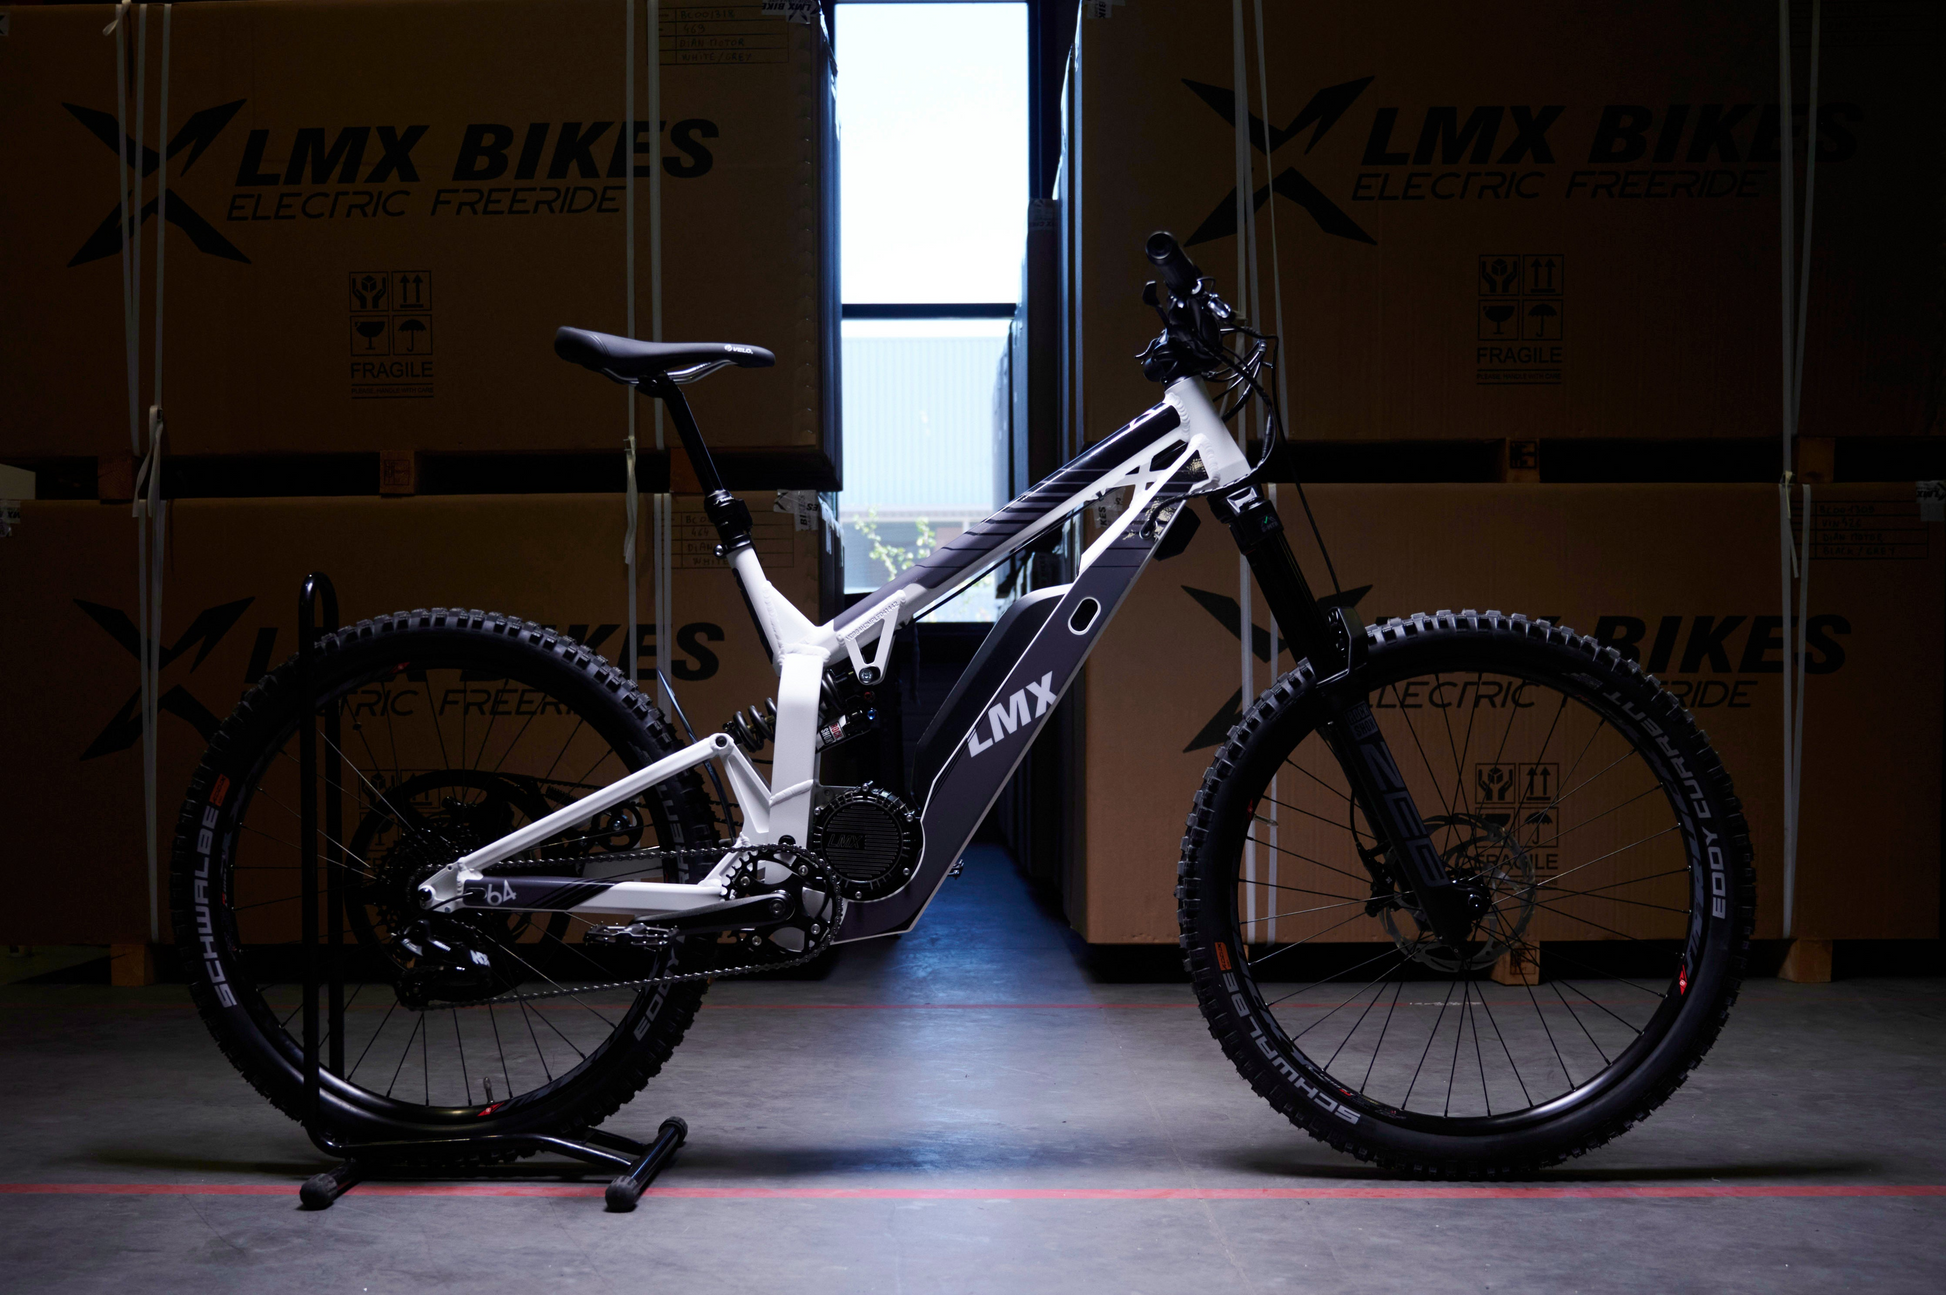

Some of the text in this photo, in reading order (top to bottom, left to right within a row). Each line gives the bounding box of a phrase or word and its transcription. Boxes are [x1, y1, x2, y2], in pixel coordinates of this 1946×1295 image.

[1361, 101, 1864, 165] LMX BIKES
[235, 119, 719, 186] LMX BIKES
[1352, 169, 1768, 201] ELECTRIC FREERIDE
[226, 186, 626, 221] ELECTRIC FREERIDE
[351, 361, 434, 379] FRAGILE
[1477, 346, 1563, 364] FRAGILE
[1366, 681, 1542, 709] LECTRIC
[967, 671, 1058, 758] LMX
[1347, 702, 1370, 724] ROCK
[1602, 690, 1727, 920] EDDY CURRENT
[827, 833, 864, 849] LMX
[193, 804, 238, 1008] SCHWALBE
[487, 879, 518, 906] 64
[1222, 971, 1362, 1126] SCHWALBE
